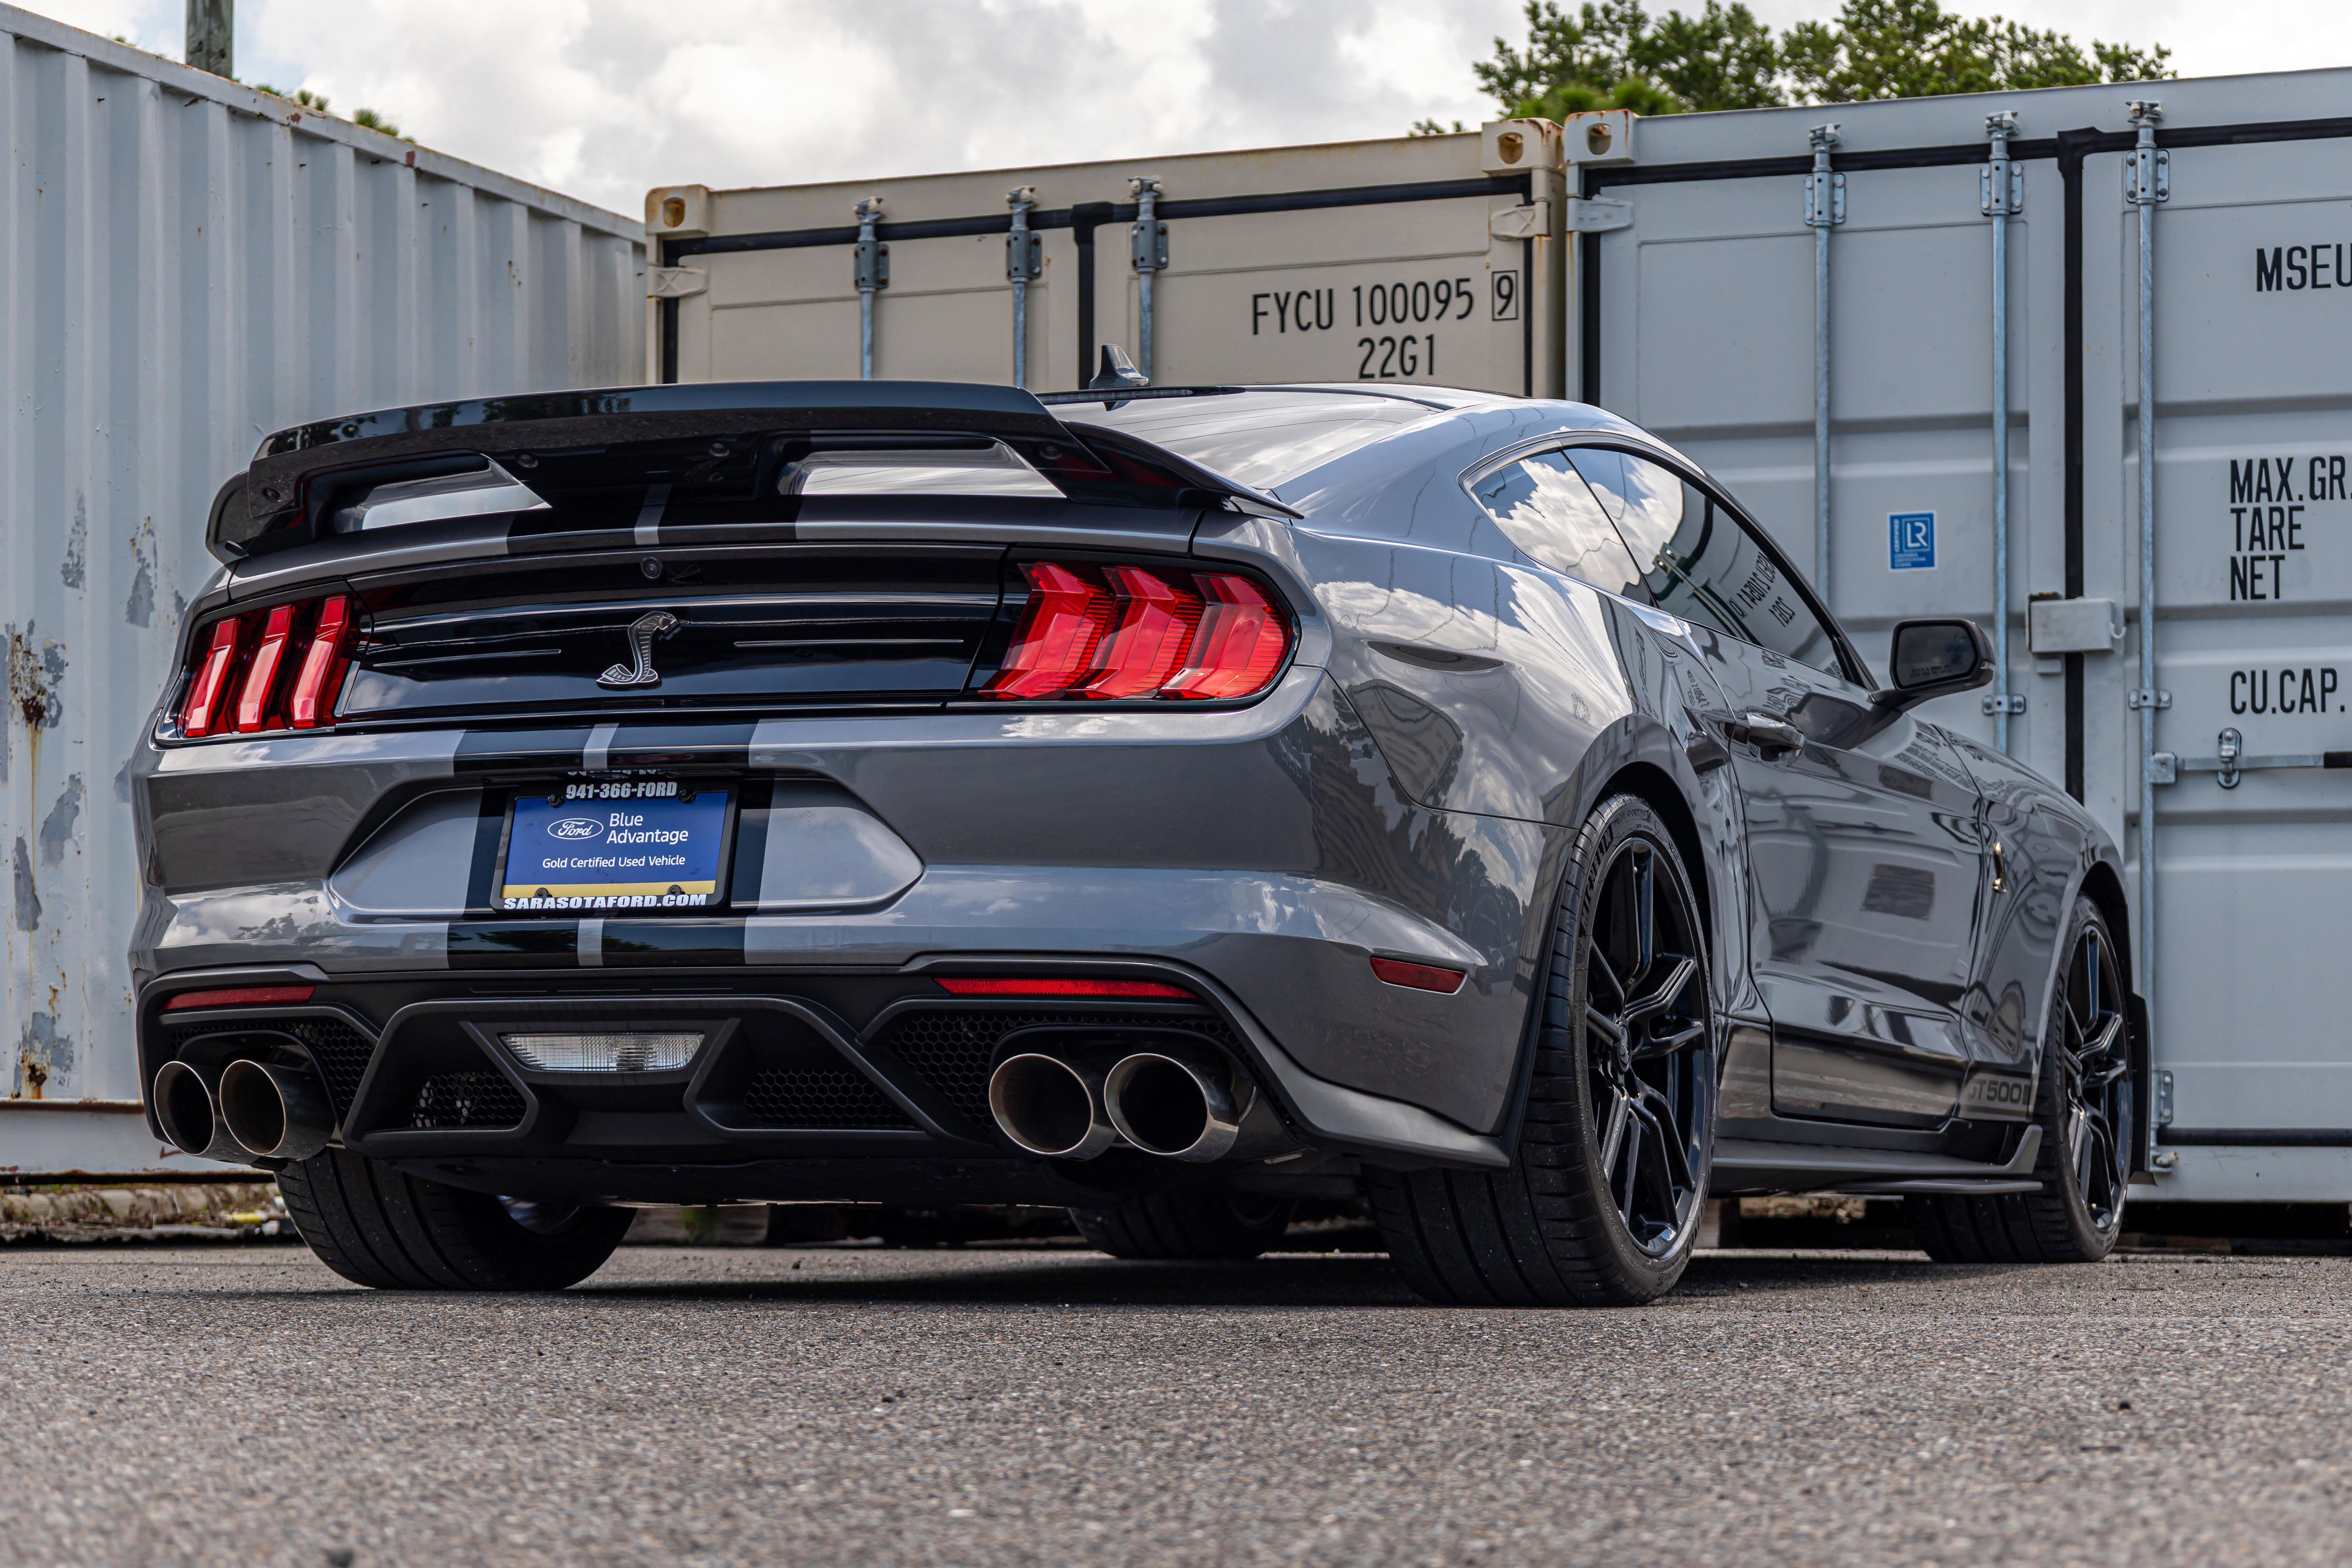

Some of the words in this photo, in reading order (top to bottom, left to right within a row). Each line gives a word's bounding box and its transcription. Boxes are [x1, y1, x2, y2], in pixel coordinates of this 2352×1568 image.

[2256, 243, 2352, 292] MSEU
[1252, 288, 1334, 335] FYCU
[1352, 278, 1473, 327] 100095
[1496, 274, 1514, 316] 9
[1357, 334, 1434, 379] 22G1
[1907, 521, 1928, 548] LR
[2230, 505, 2305, 552] TARE
[2230, 554, 2285, 601] NET
[2230, 668, 2345, 714] CU.CAP.
[566, 782, 677, 799] 941-366-FORD
[558, 821, 593, 836] Ford
[609, 812, 644, 827] Blue
[606, 829, 688, 845] Advantage
[542, 858, 568, 869] Gold
[570, 857, 615, 868] Certified
[618, 856, 646, 867] Used
[648, 855, 686, 866] Vehicle
[503, 894, 706, 909] SARASOTAFORD.COM
